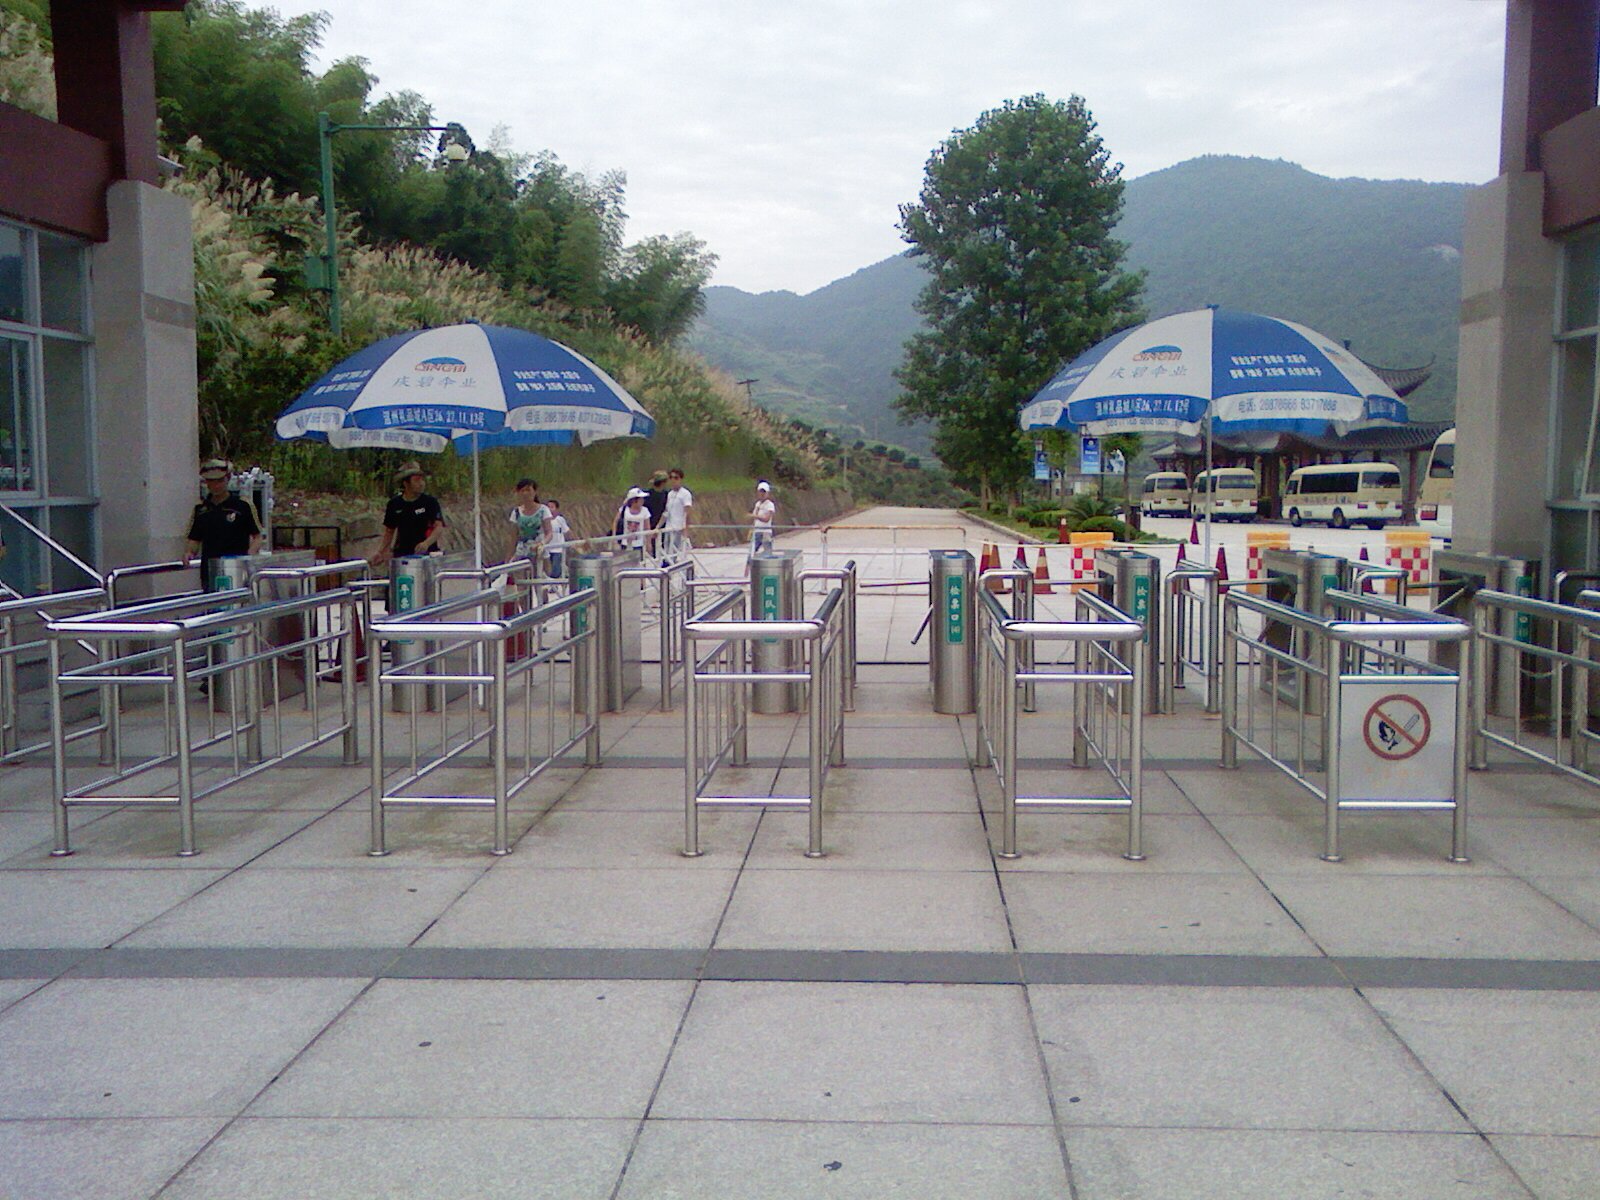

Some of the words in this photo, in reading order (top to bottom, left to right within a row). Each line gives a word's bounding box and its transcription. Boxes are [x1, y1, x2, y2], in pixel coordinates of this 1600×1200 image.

[765, 586, 776, 621] 团队通
[1136, 585, 1148, 621] 检票口
